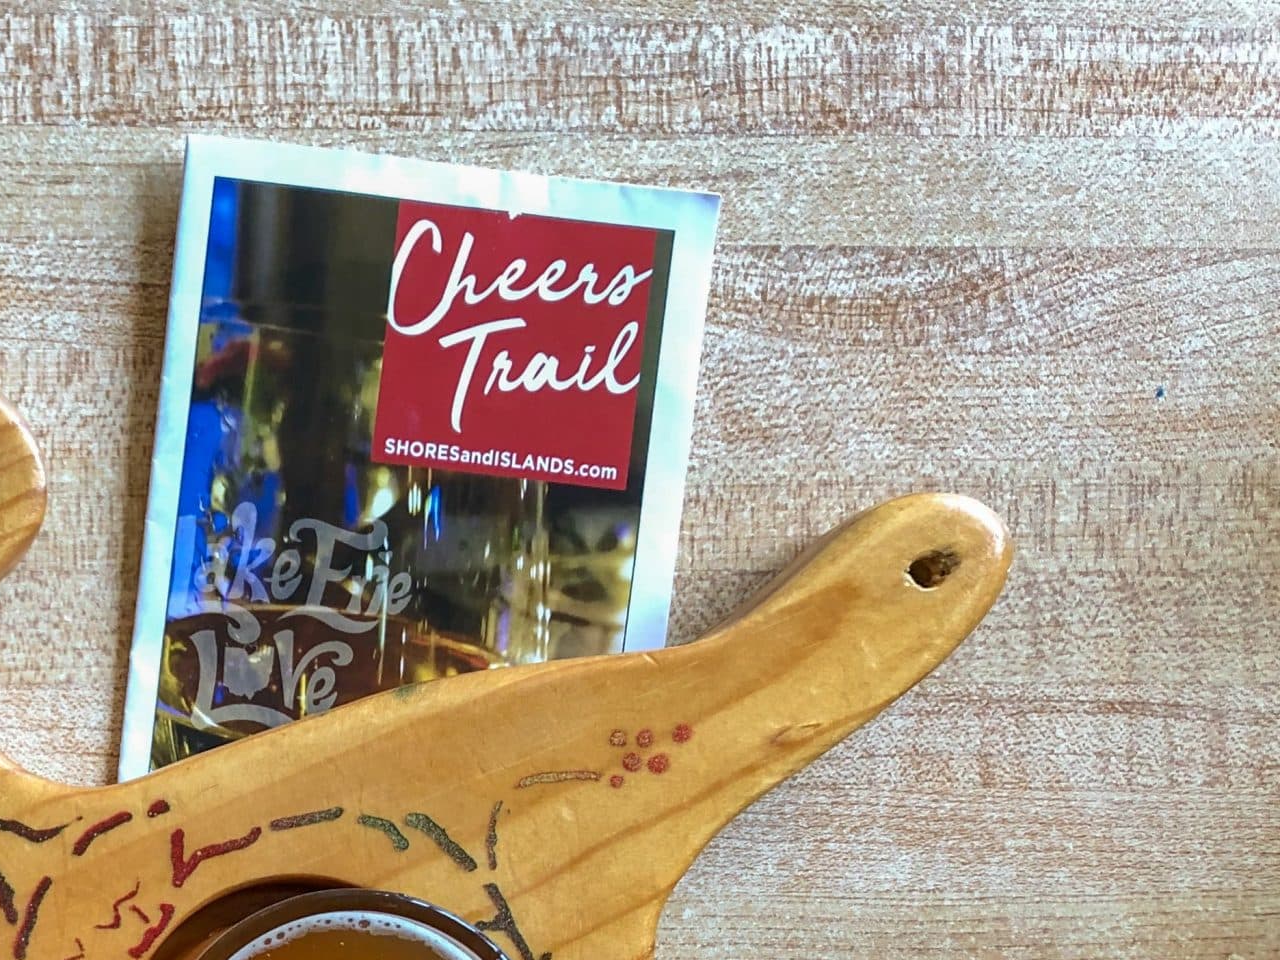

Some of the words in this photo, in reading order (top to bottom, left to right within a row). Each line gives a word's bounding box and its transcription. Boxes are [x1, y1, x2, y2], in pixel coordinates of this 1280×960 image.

[387, 218, 653, 336] Cheers
[438, 318, 640, 434] Trail
[384, 438, 618, 481] SHORESandISLANDS.com
[167, 501, 303, 644] Lake
[277, 518, 413, 635] Erie
